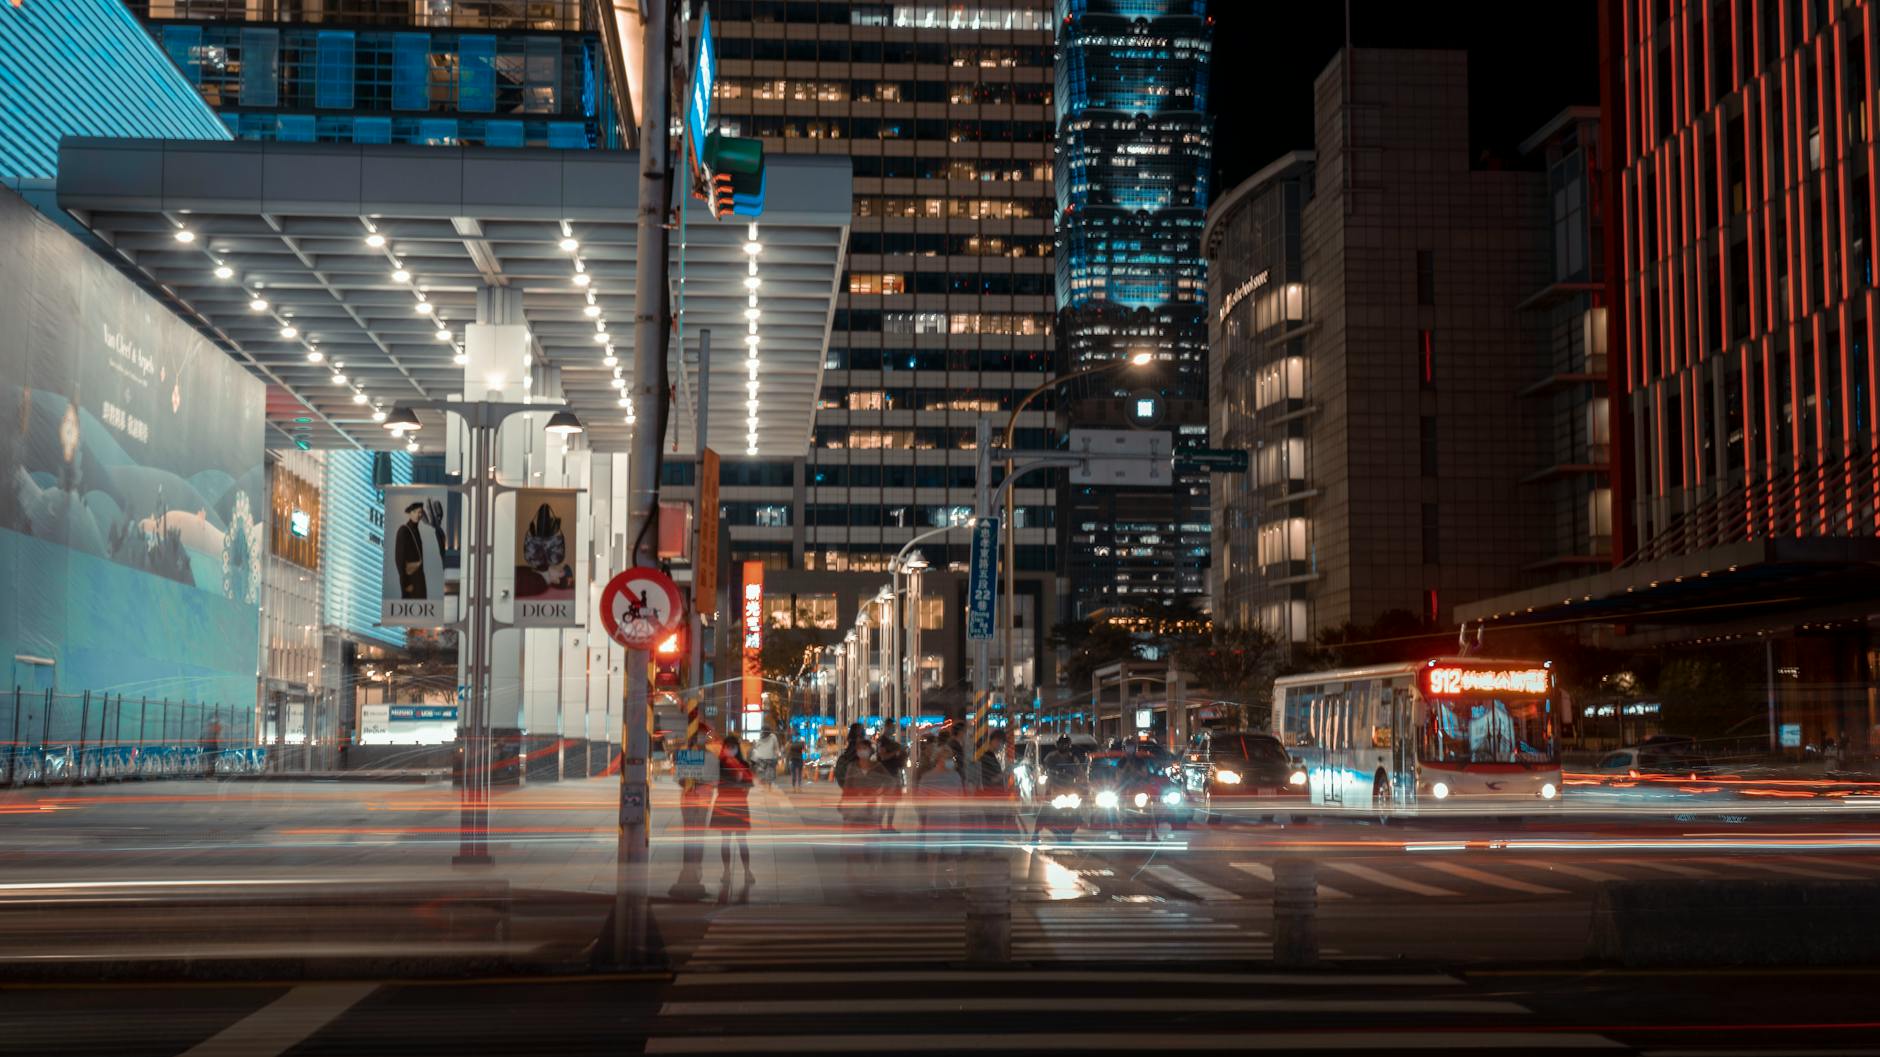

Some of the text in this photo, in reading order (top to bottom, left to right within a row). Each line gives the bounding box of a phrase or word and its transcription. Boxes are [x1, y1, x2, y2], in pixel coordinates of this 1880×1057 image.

[390, 603, 435, 617] DIOR
[522, 603, 567, 618] DIOR
[745, 583, 761, 649] 新光三越
[1430, 668, 1462, 694] 912
